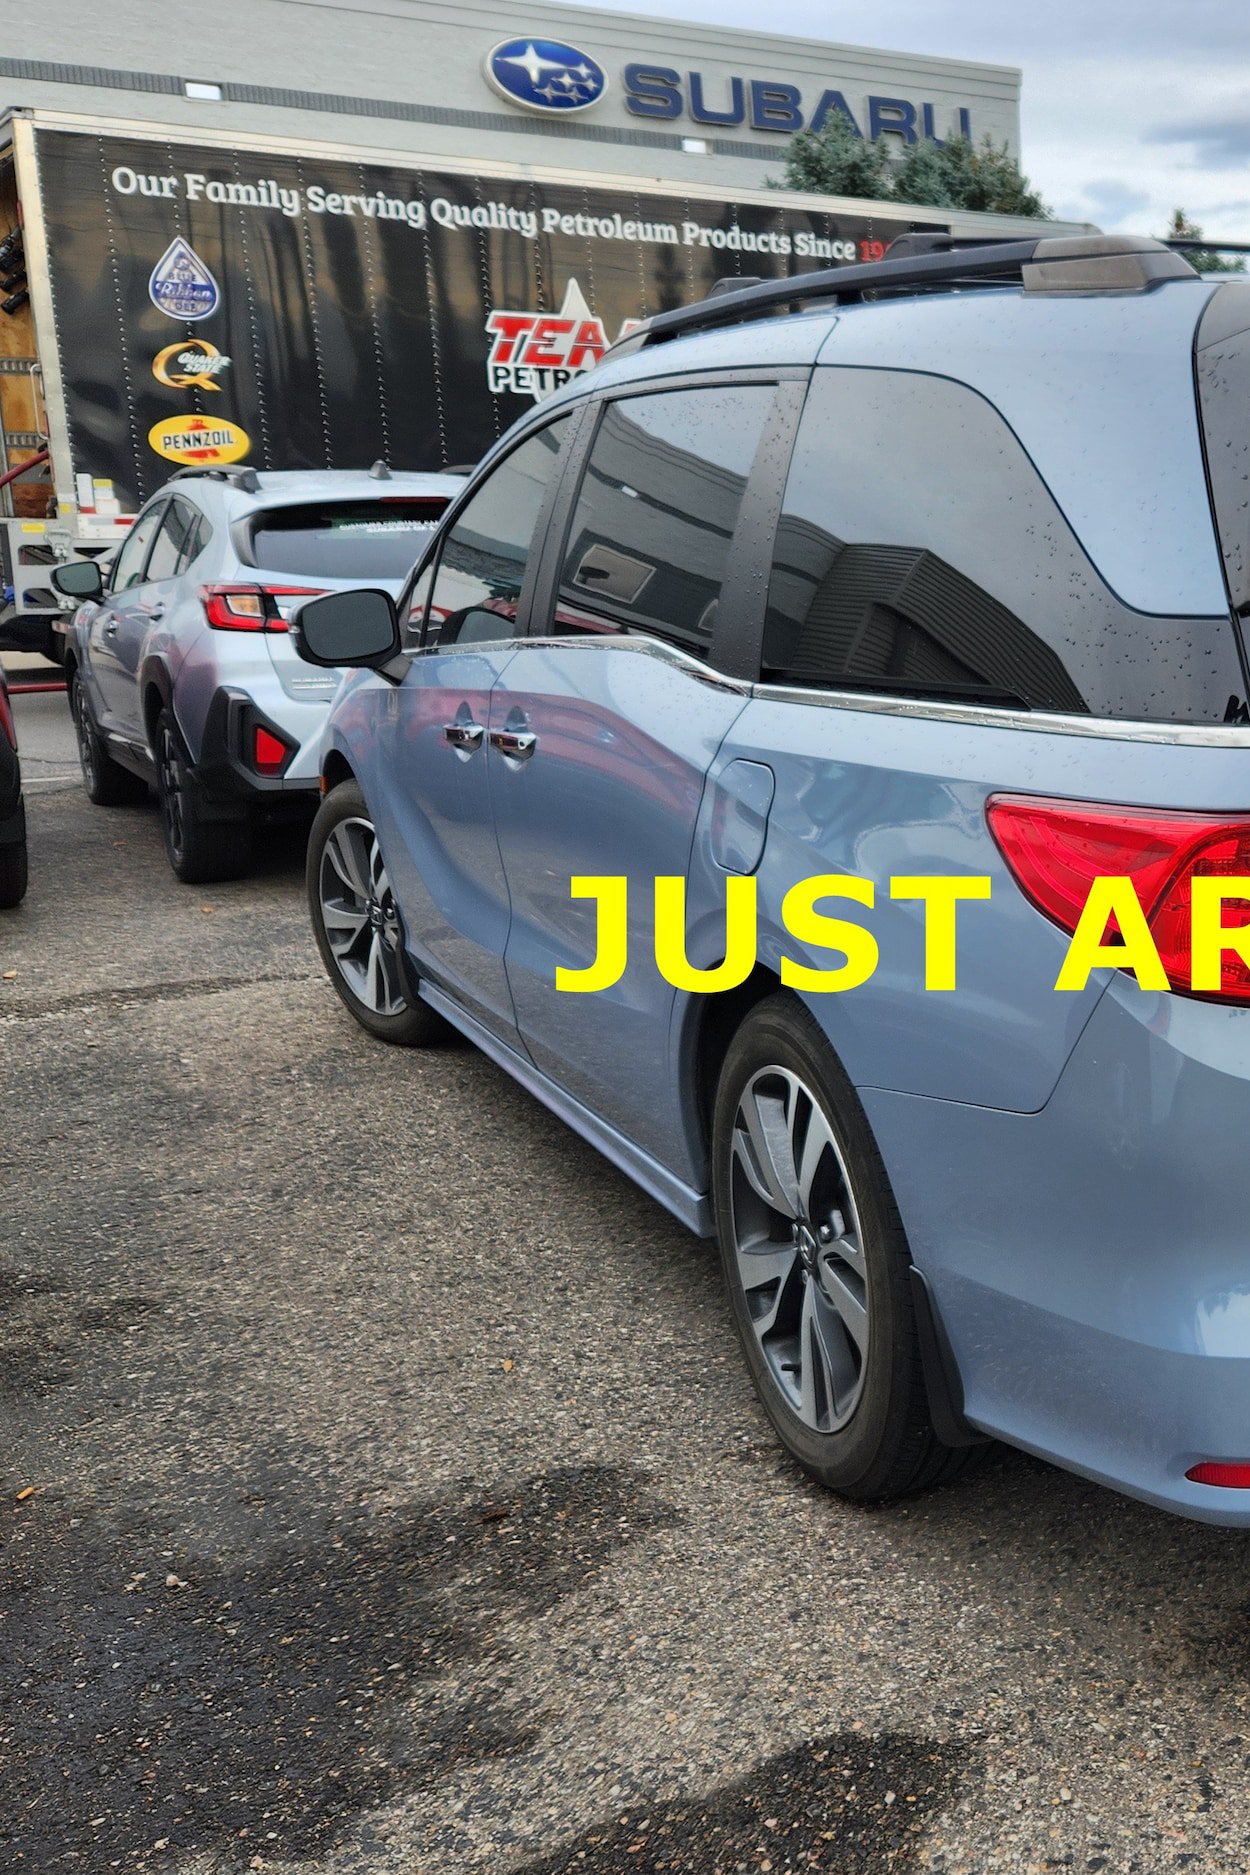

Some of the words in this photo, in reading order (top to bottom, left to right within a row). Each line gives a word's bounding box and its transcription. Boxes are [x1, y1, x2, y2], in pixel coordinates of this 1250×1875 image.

[623, 62, 973, 149] SUBARU
[110, 166, 178, 198] Our
[183, 172, 301, 218] Family
[306, 186, 429, 229] Serving
[429, 197, 536, 240] Quality
[541, 207, 680, 245] Petroleum
[682, 221, 792, 255] Products
[793, 231, 857, 261] Since
[859, 239, 891, 262] 19
[490, 314, 637, 368] TEA
[492, 365, 589, 391] PETR
[163, 430, 234, 450] PENNZOIL
